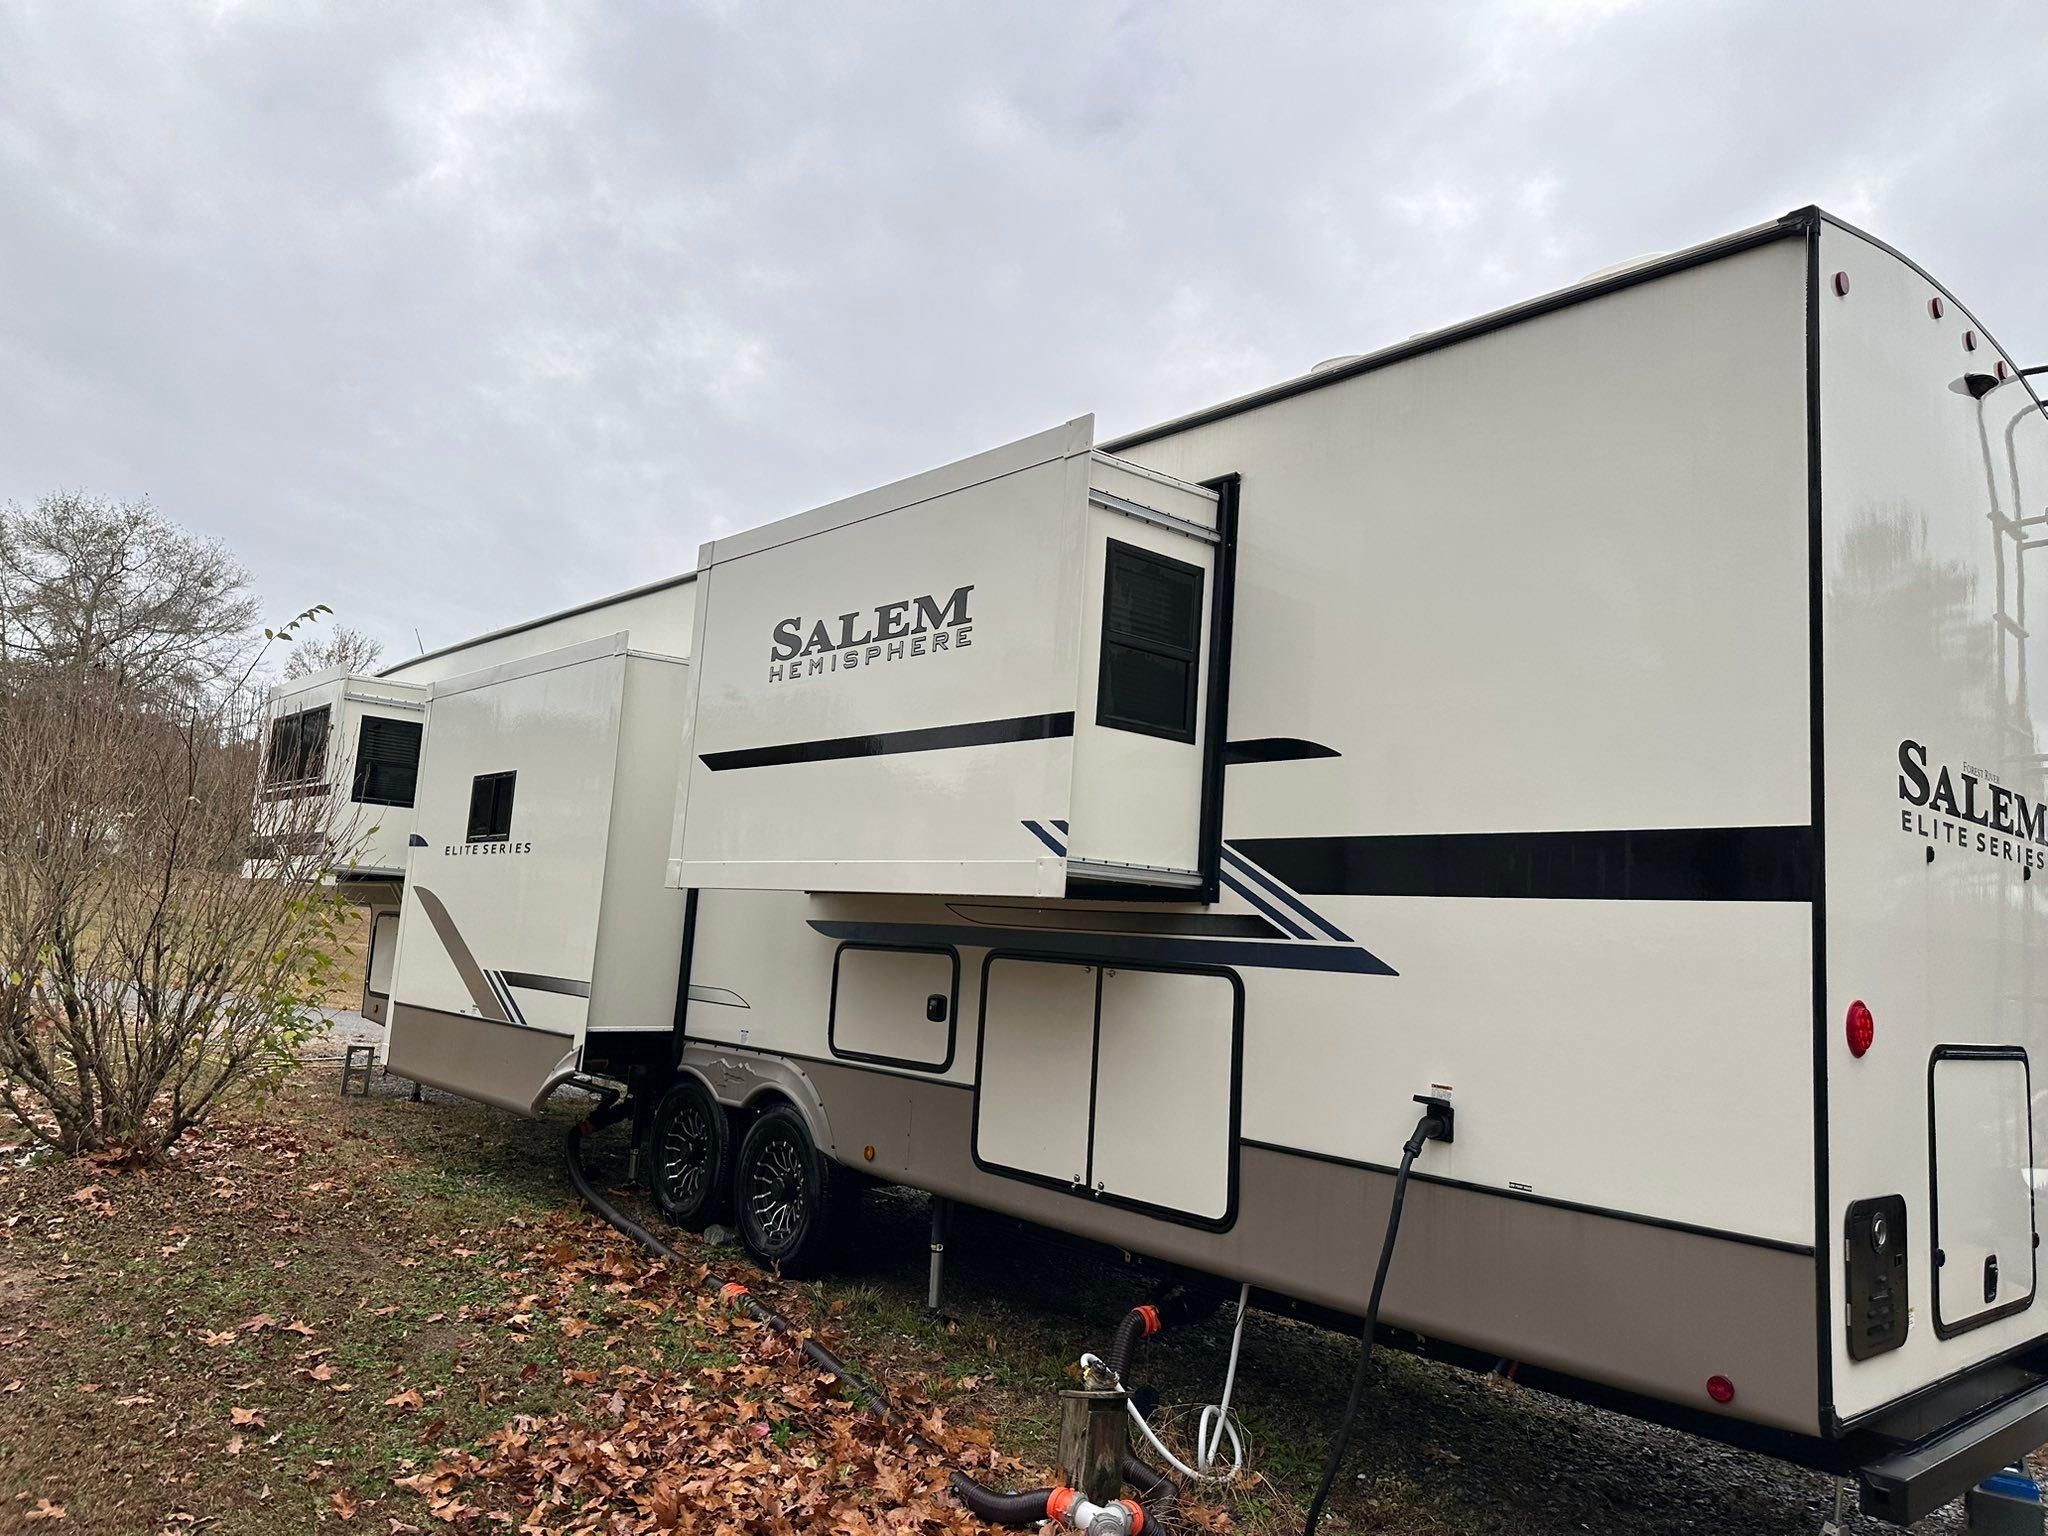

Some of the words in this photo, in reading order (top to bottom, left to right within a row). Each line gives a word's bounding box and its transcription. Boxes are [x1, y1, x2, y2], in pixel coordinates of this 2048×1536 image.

[771, 585, 975, 662] SALEM
[769, 626, 973, 683] HEMISPHERE
[1898, 739, 2048, 847] SALEM
[1963, 761, 1984, 778] FOREST
[445, 845, 479, 856] ELITE
[482, 842, 532, 855] SERIES
[1901, 810, 1968, 848] ELITE
[1976, 833, 2045, 870] SERIES
